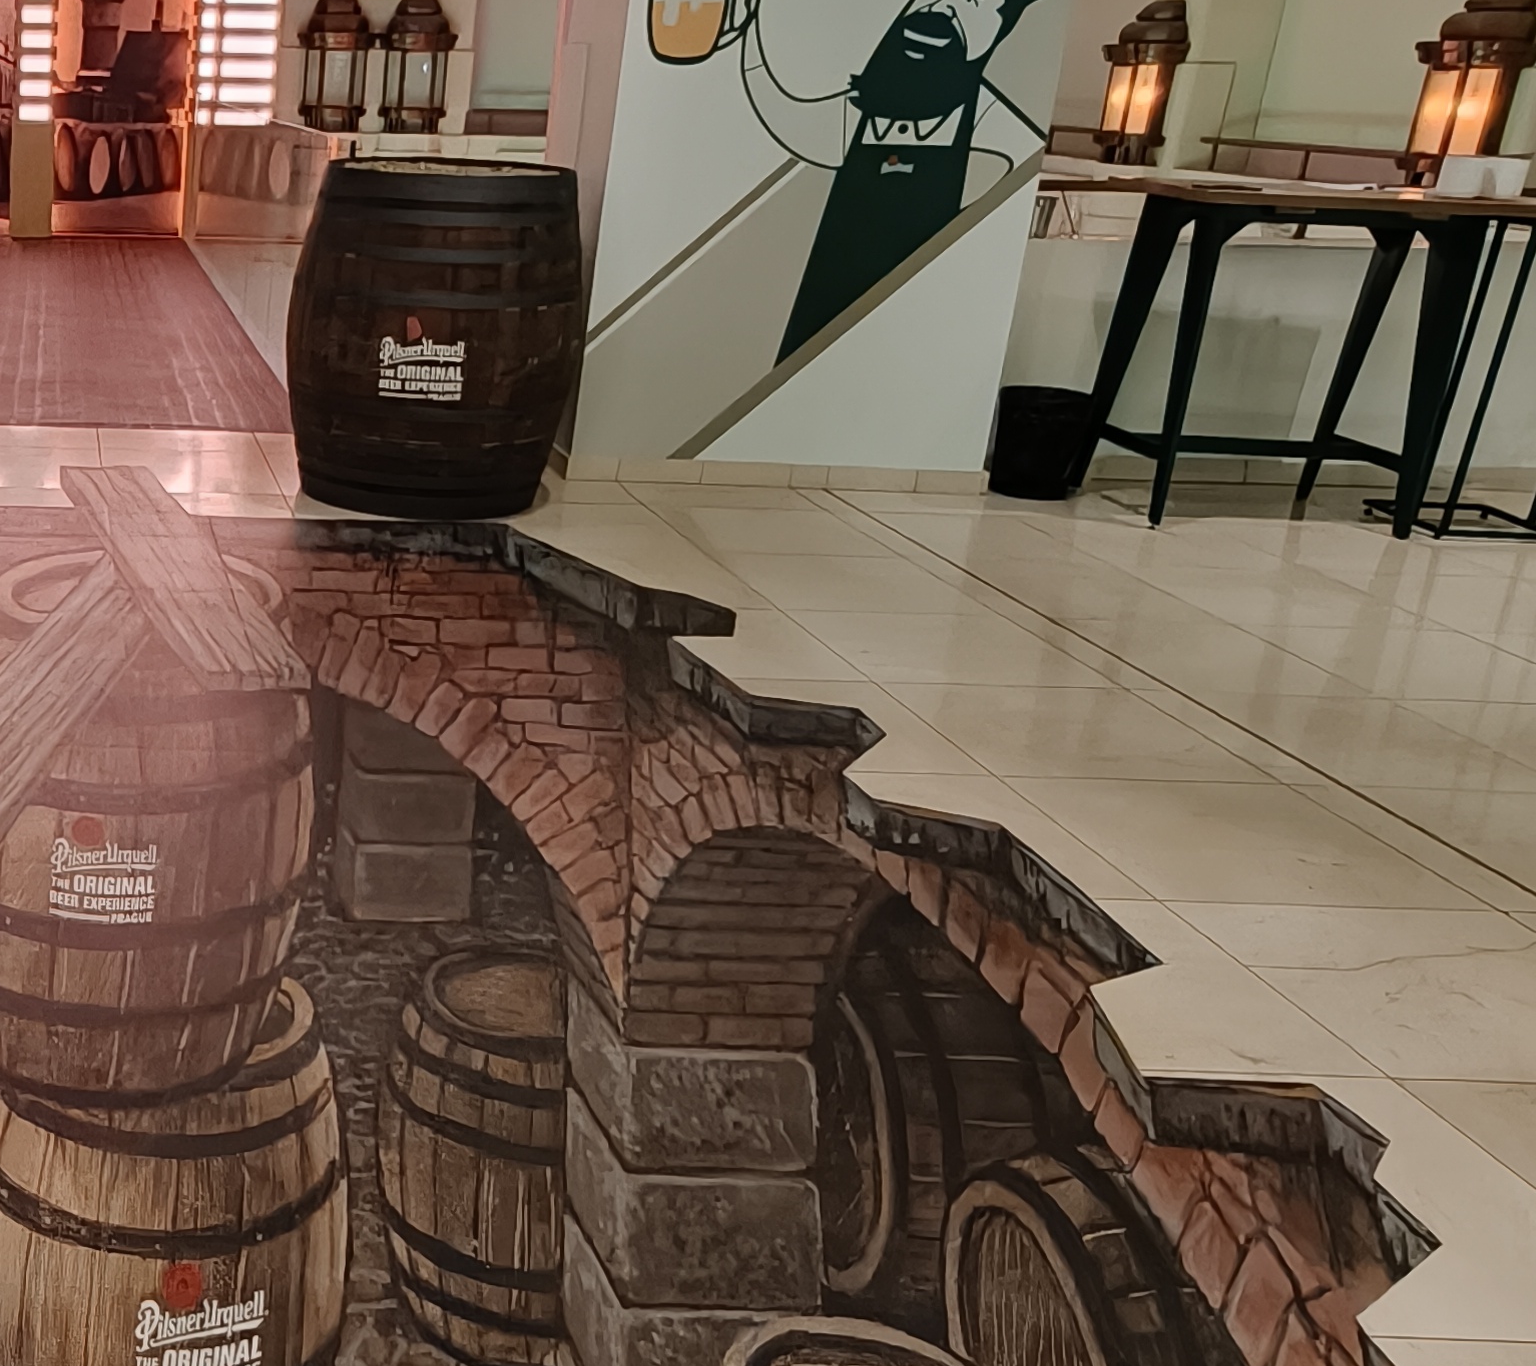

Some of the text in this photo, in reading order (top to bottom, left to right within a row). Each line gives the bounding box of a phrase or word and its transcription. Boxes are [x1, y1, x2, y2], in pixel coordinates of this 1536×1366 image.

[396, 365, 464, 381] ORIGINAL
[50, 837, 157, 874] Pilsner Urquell
[73, 874, 155, 895] ORIGINAL
[49, 890, 155, 911] BEER EXPERIENCE
[110, 911, 153, 924] PRAGUE
[134, 1289, 265, 1352] Pilsner Urquell
